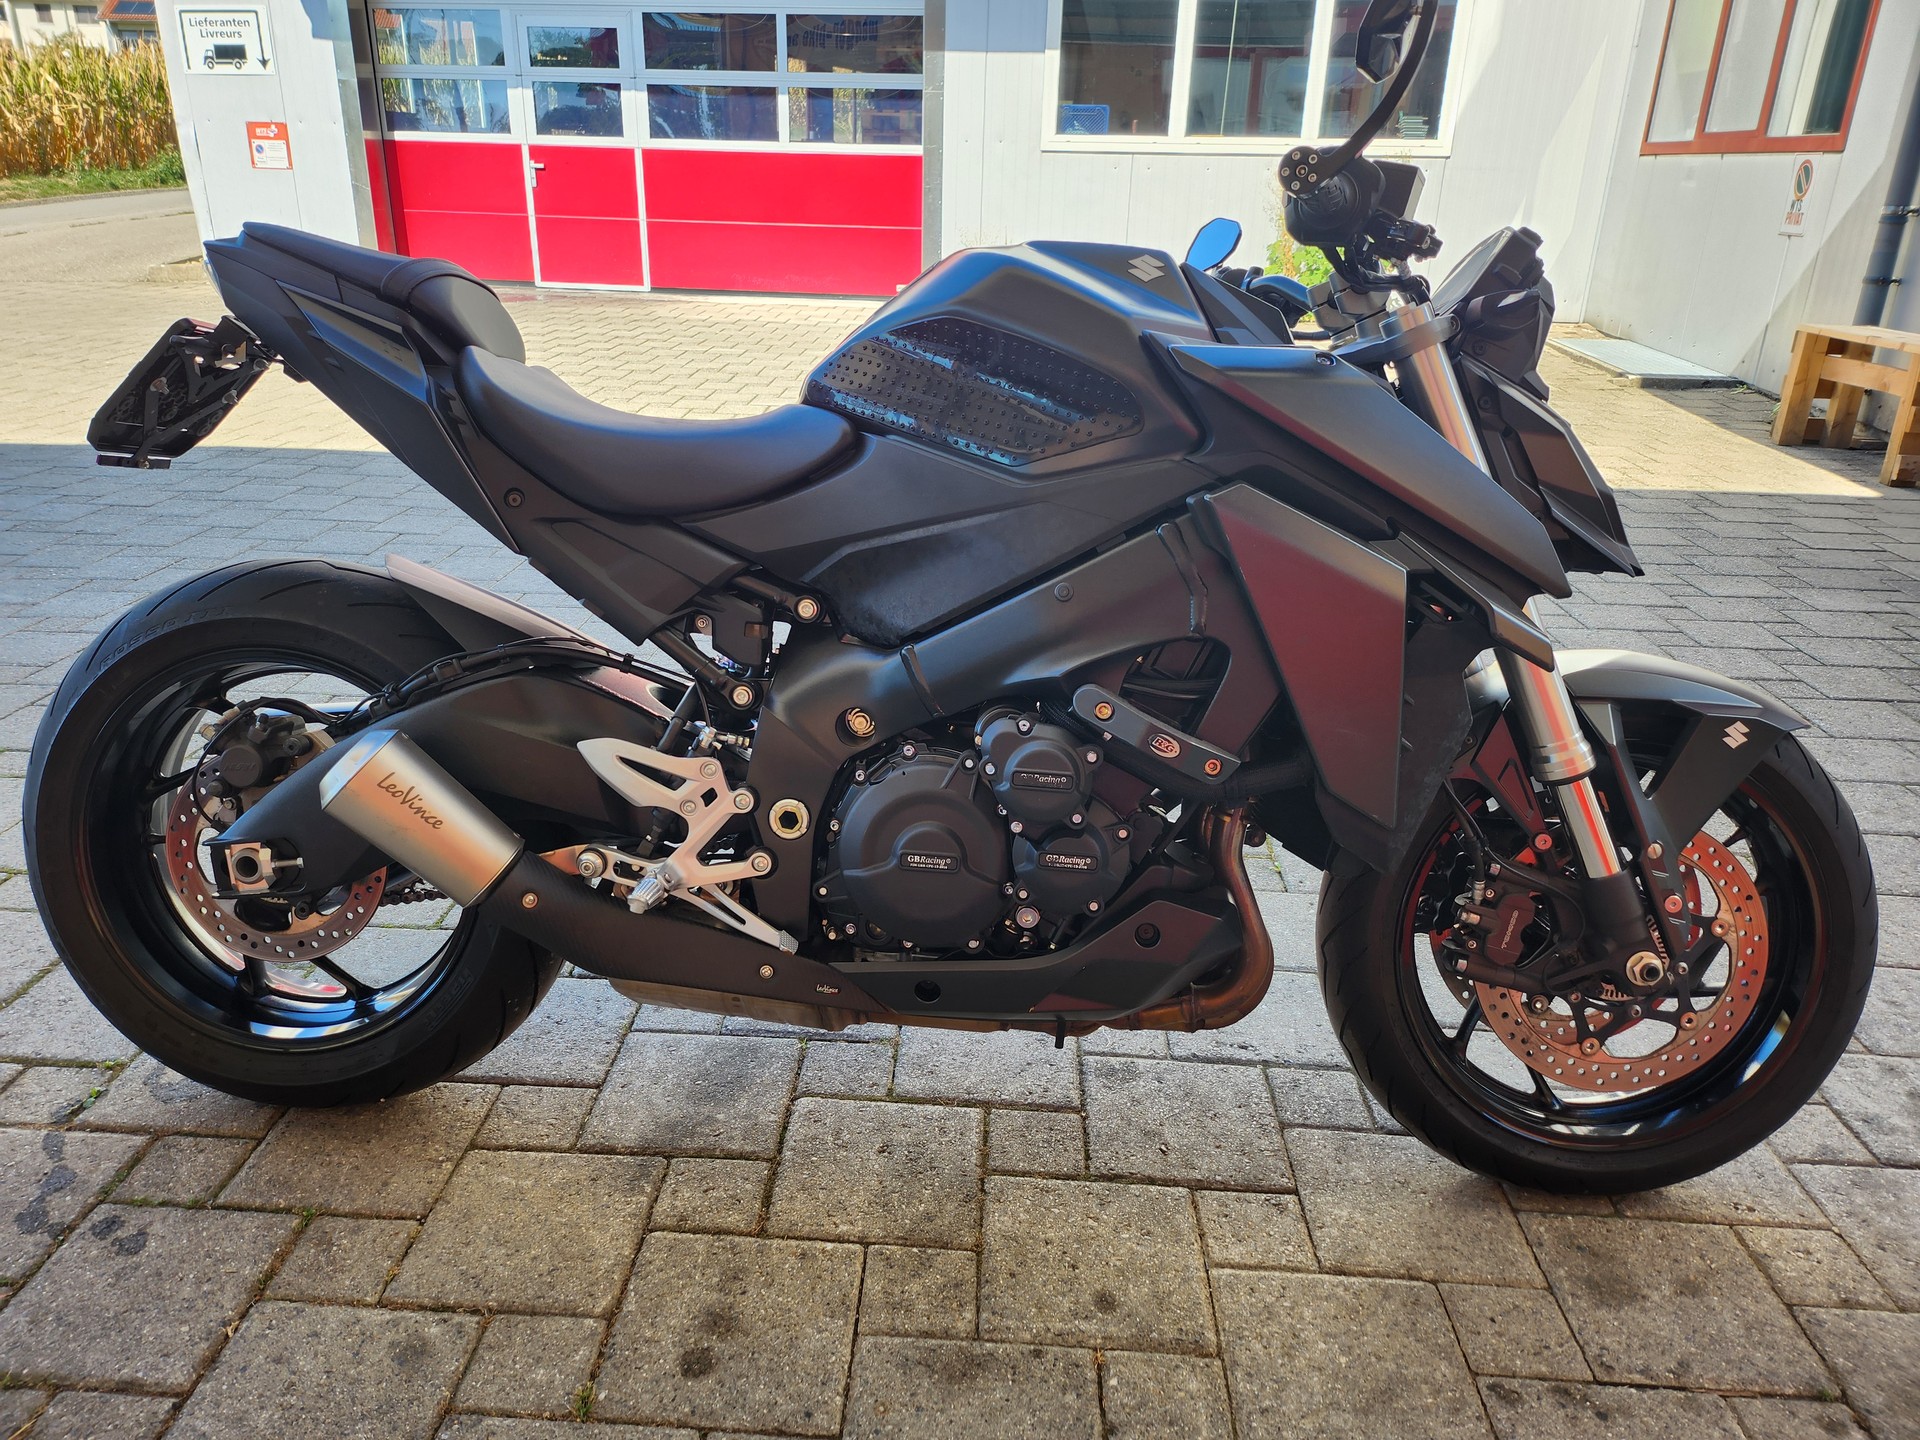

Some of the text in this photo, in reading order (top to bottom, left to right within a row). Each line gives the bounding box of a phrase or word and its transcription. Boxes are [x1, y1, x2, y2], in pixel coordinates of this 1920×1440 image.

[188, 17, 251, 28] Lieferanten
[199, 28, 243, 39] Livreurs
[1153, 737, 1176, 753] R&G
[376, 771, 443, 830] LeoVince
